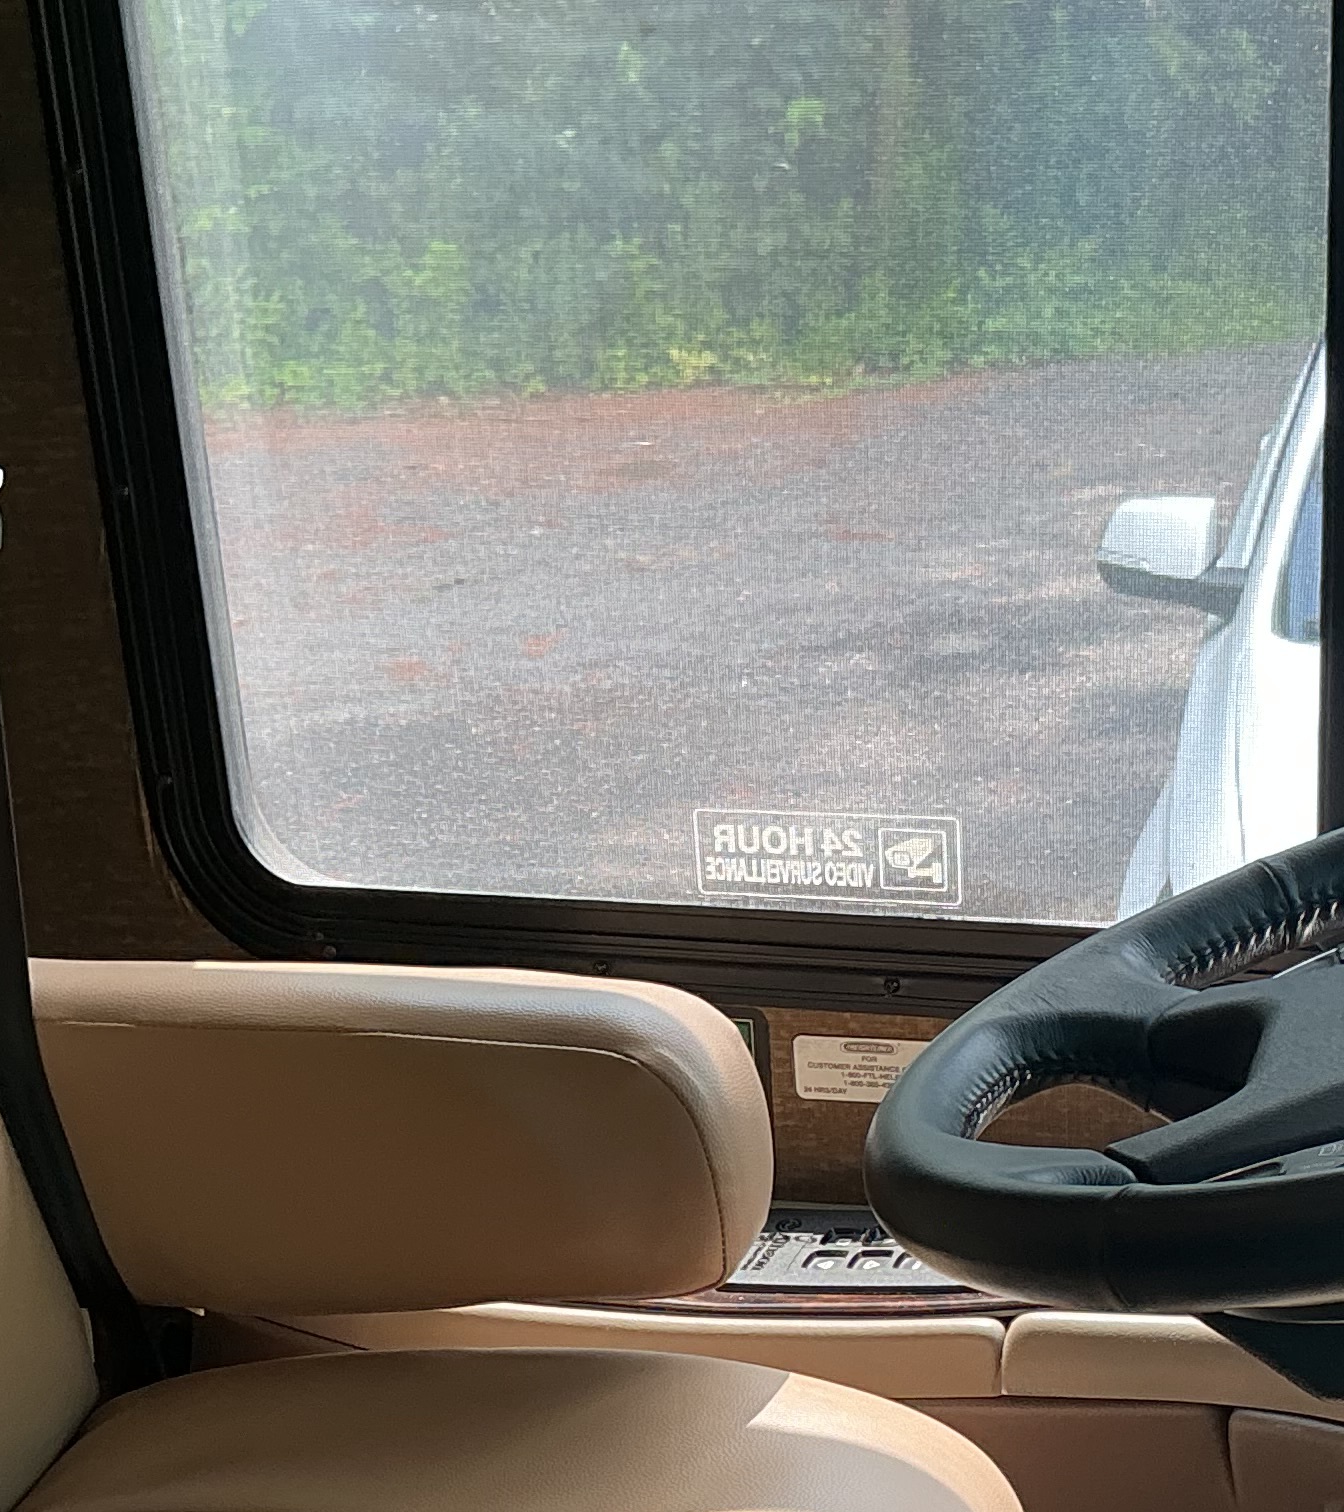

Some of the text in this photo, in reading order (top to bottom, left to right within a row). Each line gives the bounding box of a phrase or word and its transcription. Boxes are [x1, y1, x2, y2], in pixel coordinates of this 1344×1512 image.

[861, 1055, 878, 1063] FOR
[807, 1061, 851, 1070] CUSTOMER
[853, 1064, 900, 1072] ASSISTANCE
